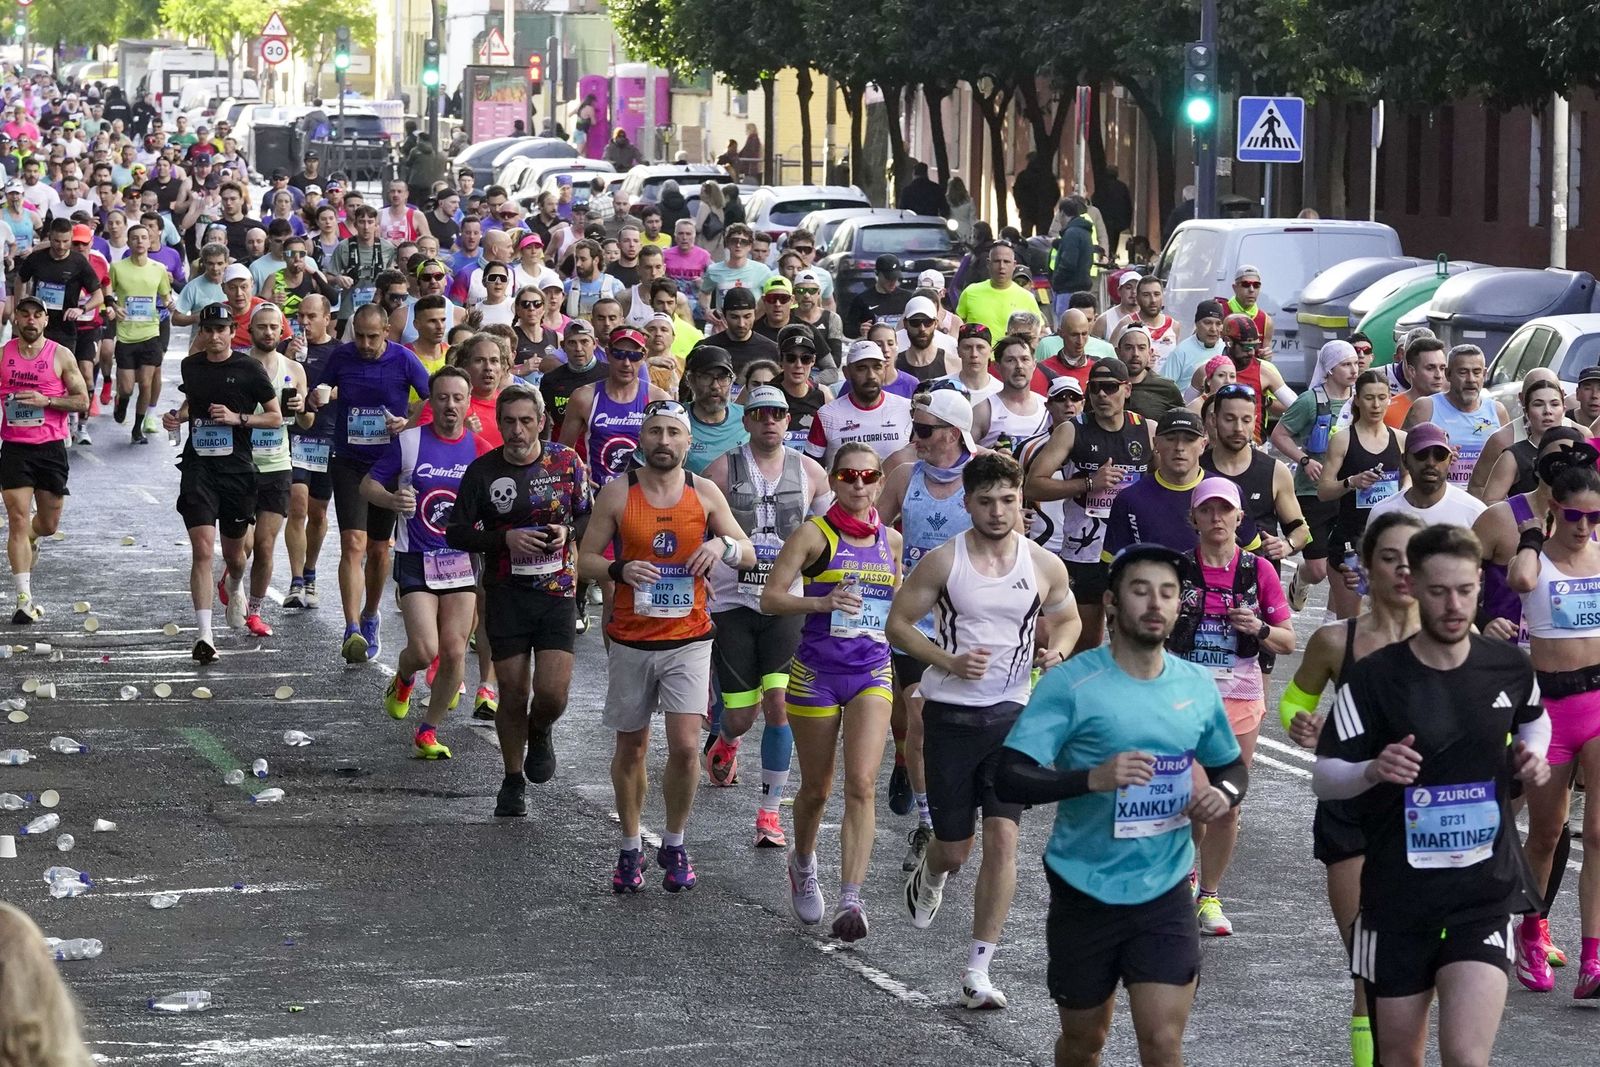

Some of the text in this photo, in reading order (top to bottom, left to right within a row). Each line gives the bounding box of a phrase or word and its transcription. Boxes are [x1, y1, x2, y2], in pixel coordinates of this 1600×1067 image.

[266, 46, 284, 56] 30
[1281, 339, 1300, 350] MFY
[15, 410, 34, 418] BUEY
[361, 407, 384, 415] ZURIC
[882, 432, 899, 441] SOLO
[196, 437, 228, 447] IGNACIO
[306, 454, 328, 464] JAVIER
[1079, 461, 1099, 470] LOS
[1086, 497, 1112, 508] HUGO
[512, 555, 532, 565] JUAN
[841, 559, 859, 570] ELS
[657, 566, 689, 575] ZURICH
[655, 583, 674, 591] 6173
[860, 585, 888, 598] ZURICH
[673, 594, 693, 605] G.S.
[1577, 600, 1597, 609] 7196
[1149, 783, 1173, 795] 7924
[1437, 787, 1486, 802] ZURICH
[1117, 799, 1176, 819] XANKLY
[1440, 814, 1466, 827] 8731
[1411, 826, 1496, 849] MARTINEZ
